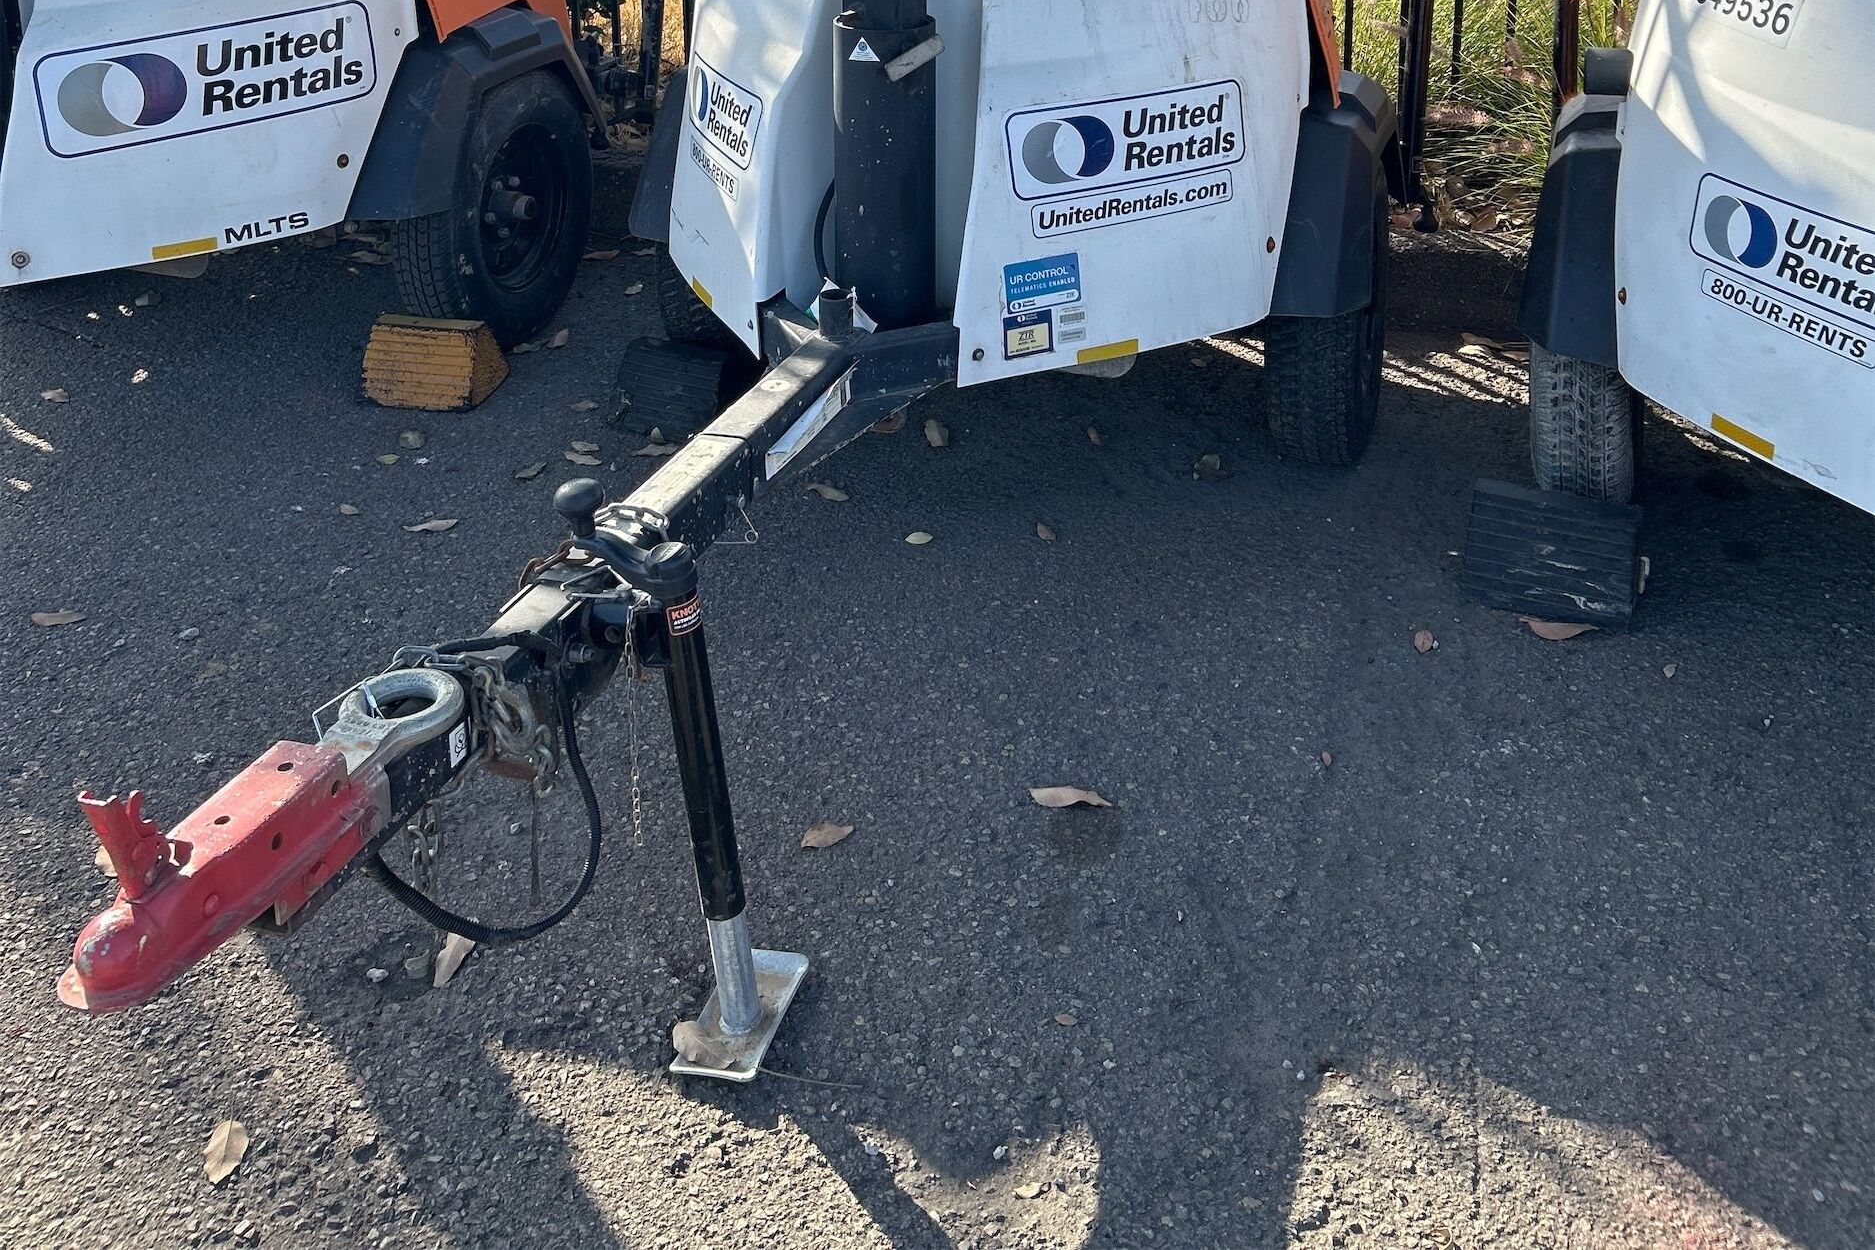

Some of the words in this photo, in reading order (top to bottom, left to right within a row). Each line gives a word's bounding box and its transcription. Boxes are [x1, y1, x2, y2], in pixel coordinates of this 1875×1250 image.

[196, 17, 345, 77] United
[202, 55, 363, 117] Rentals
[710, 81, 753, 128] United
[707, 107, 749, 158] Rentals
[1122, 94, 1224, 139] United
[1124, 126, 1236, 172] Rentals
[224, 211, 310, 244] MLTS
[1038, 180, 1227, 230] UnitedRentals.com
[1009, 274, 1024, 285] UR
[1024, 266, 1069, 283] CONTROL
[1010, 282, 1047, 295] TELEMATICS
[1049, 276, 1076, 288] ENABLED
[1710, 278, 1868, 358] 800-UR-RENTS
